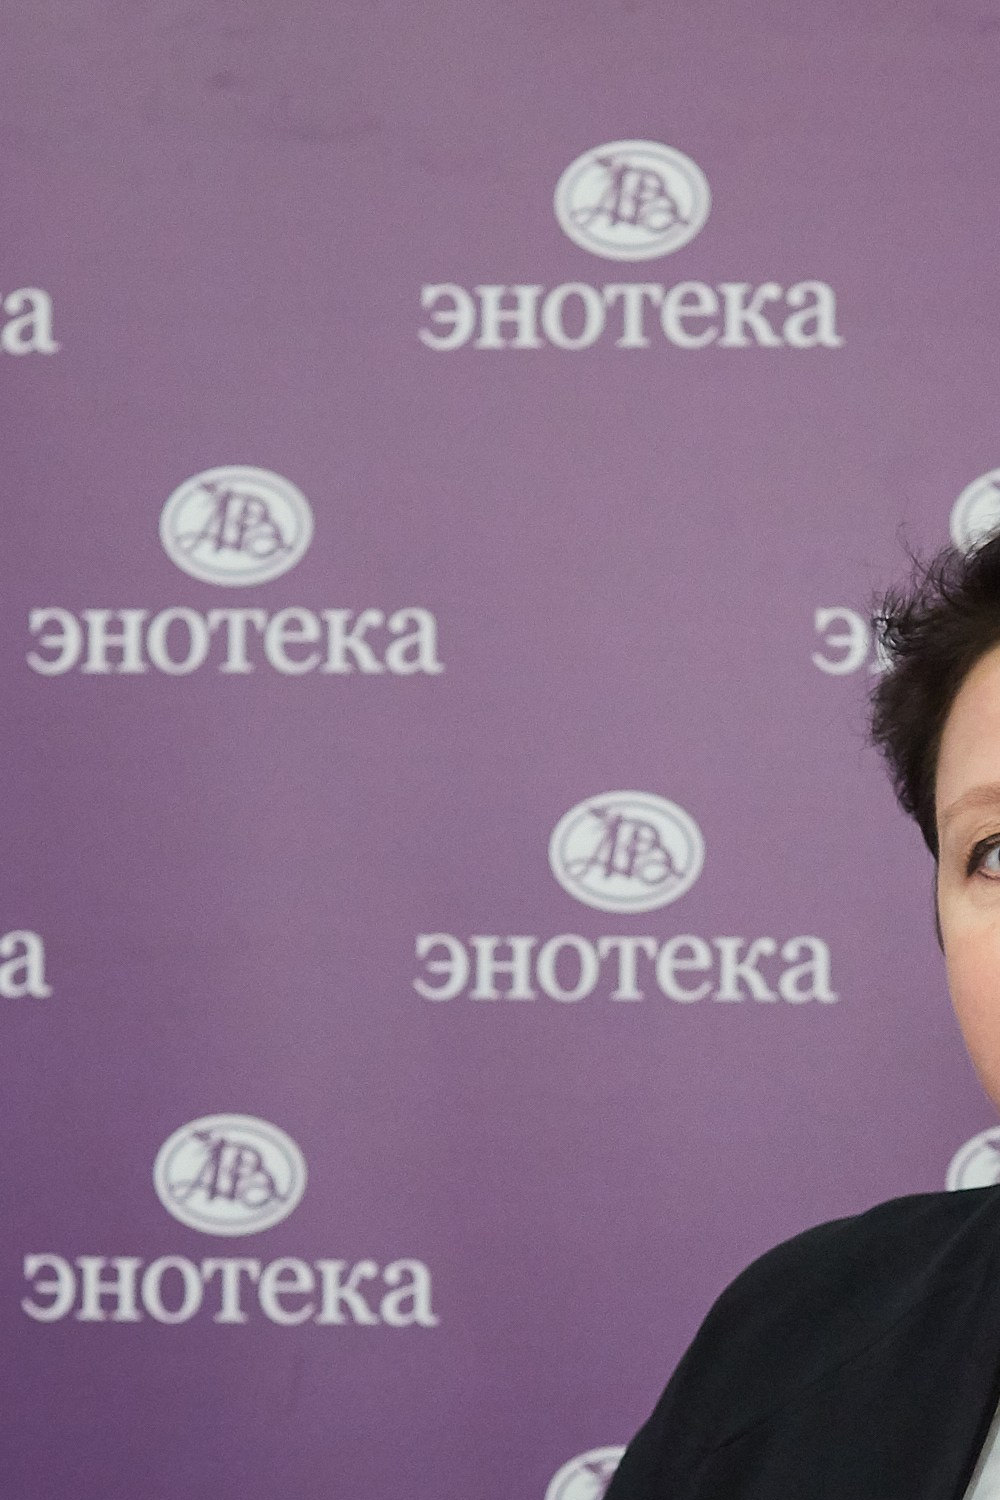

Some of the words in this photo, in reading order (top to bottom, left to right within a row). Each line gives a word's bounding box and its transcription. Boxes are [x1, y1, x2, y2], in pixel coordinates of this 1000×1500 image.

[421, 280, 842, 351] энотека
[29, 606, 443, 676] энотека
[414, 933, 837, 1004] энотека
[23, 1254, 438, 1328] энотека
